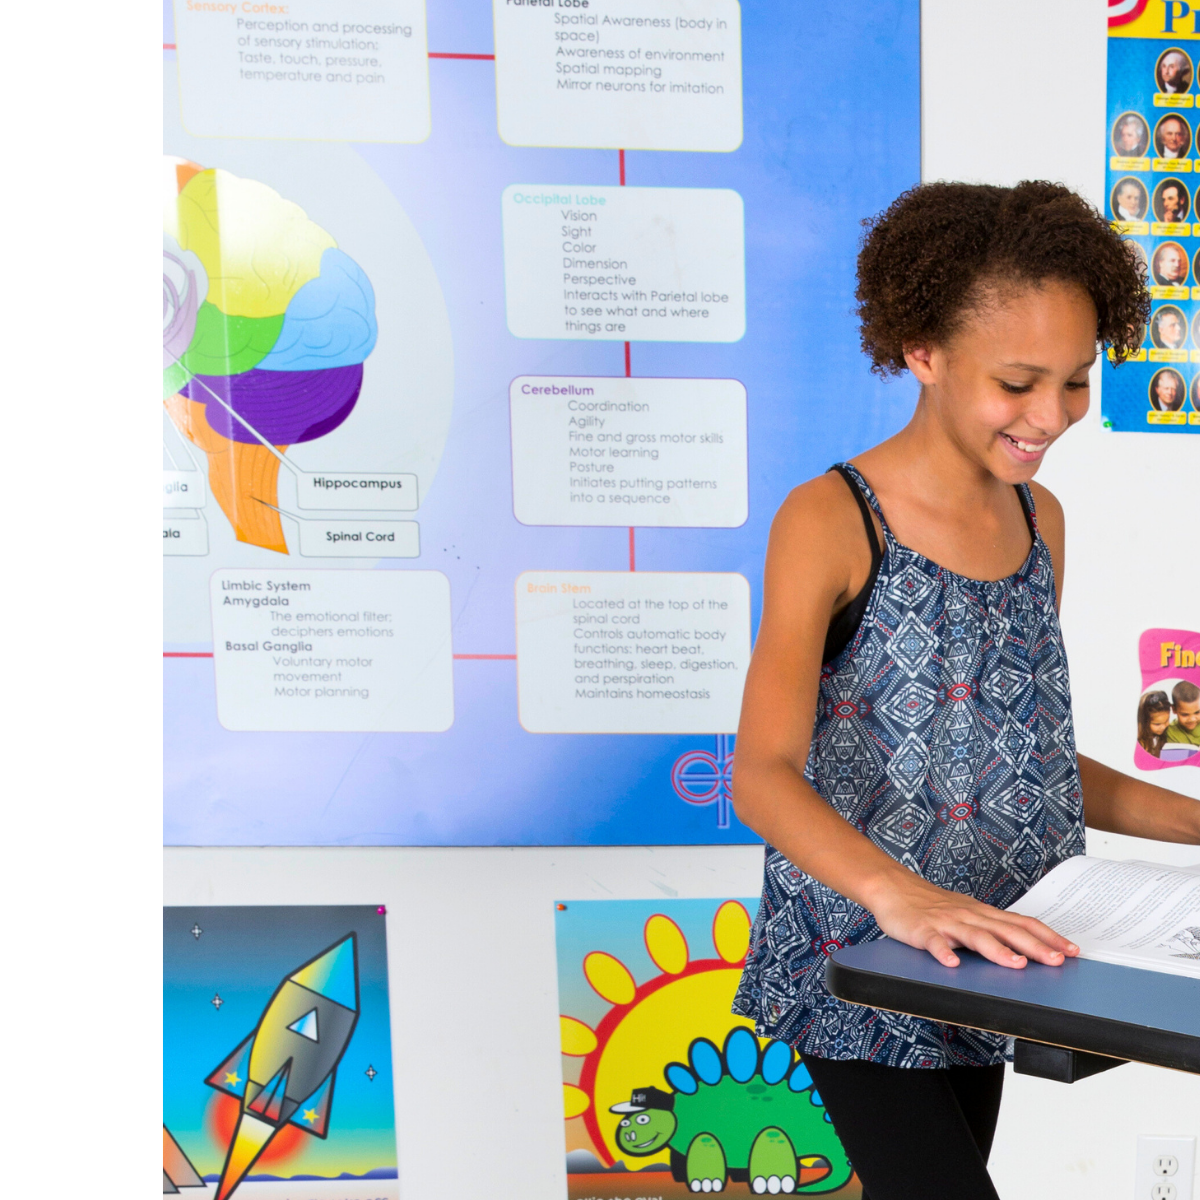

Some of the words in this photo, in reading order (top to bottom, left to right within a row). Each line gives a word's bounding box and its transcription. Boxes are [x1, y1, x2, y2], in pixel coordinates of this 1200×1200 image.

[242, 1, 289, 14] Cortex:
[558, 0, 589, 9] Lobe
[237, 18, 309, 33] Perception
[312, 21, 339, 33] and
[342, 22, 412, 38] processing
[554, 12, 598, 27] Spatial
[602, 15, 671, 28] Awareness
[675, 17, 712, 31] (body
[555, 30, 600, 43] space)
[254, 37, 302, 50] sensory
[556, 47, 625, 60] Awareness
[645, 51, 725, 62] environment
[239, 68, 322, 83] temperature
[325, 71, 352, 83] and
[356, 74, 385, 85] pain
[556, 62, 600, 76] Spatial
[603, 65, 662, 78] mapping
[557, 79, 592, 91] Mirror
[596, 81, 646, 93] neurons
[649, 81, 666, 93] for
[669, 82, 724, 94] imitation
[513, 192, 572, 207] Occipital
[575, 195, 606, 206] Lobe
[561, 210, 597, 222] Vision
[561, 225, 592, 239] Sight
[562, 242, 597, 254] Color
[563, 257, 628, 270] Dimension
[563, 274, 637, 287] Perspective
[563, 289, 618, 302] Interacts
[621, 290, 647, 302] with
[651, 291, 698, 303] Parietal
[701, 292, 729, 304] lobe
[580, 307, 603, 317] see
[605, 306, 639, 318] what
[642, 306, 667, 318] and
[670, 307, 709, 319] where
[565, 320, 602, 334] things
[605, 323, 626, 332] are
[521, 384, 594, 396] Cerebellum
[568, 400, 650, 413] Coordination
[568, 416, 605, 429] Agility
[568, 431, 593, 443] Fine
[597, 432, 622, 443] and
[626, 433, 656, 445] gross
[660, 433, 697, 444] motor
[700, 433, 724, 444] skills
[569, 447, 605, 457] Motor
[609, 447, 659, 460] learning
[569, 462, 615, 473] Posture
[313, 477, 402, 490] Hippocampus
[570, 477, 617, 489] Initiates
[619, 478, 663, 491] putting
[666, 478, 717, 491] patterns
[570, 493, 593, 503] into
[609, 493, 671, 505] sequence
[325, 531, 363, 543] Spinal
[365, 531, 395, 542] Cord
[222, 580, 263, 592] Limbic
[266, 581, 311, 594] System
[527, 583, 557, 594] Brain
[561, 583, 591, 594] Stem
[223, 595, 289, 608] Amygdala
[573, 599, 625, 610] Located
[645, 599, 664, 610] the
[668, 600, 689, 613] top
[708, 599, 728, 611] the
[270, 611, 293, 622] The
[296, 611, 360, 623] emotional
[573, 614, 608, 626] spinal
[611, 614, 640, 625] cord
[271, 626, 333, 639] deciphers
[337, 626, 394, 637] emotions
[573, 628, 624, 640] Controls
[626, 629, 690, 640] automatic
[694, 629, 726, 642] body
[225, 641, 259, 652] Basal
[263, 641, 313, 653] Ganglia
[574, 644, 633, 656] functions:
[636, 644, 669, 655] heart
[272, 656, 332, 669] Voluntary
[336, 657, 373, 667] motor
[273, 672, 342, 682] movement
[575, 674, 600, 685] and
[603, 674, 674, 687] perspiration
[274, 687, 311, 698] Motor
[315, 687, 369, 699] planning
[575, 688, 634, 699] Maintains
[636, 689, 711, 700] homeostasis
